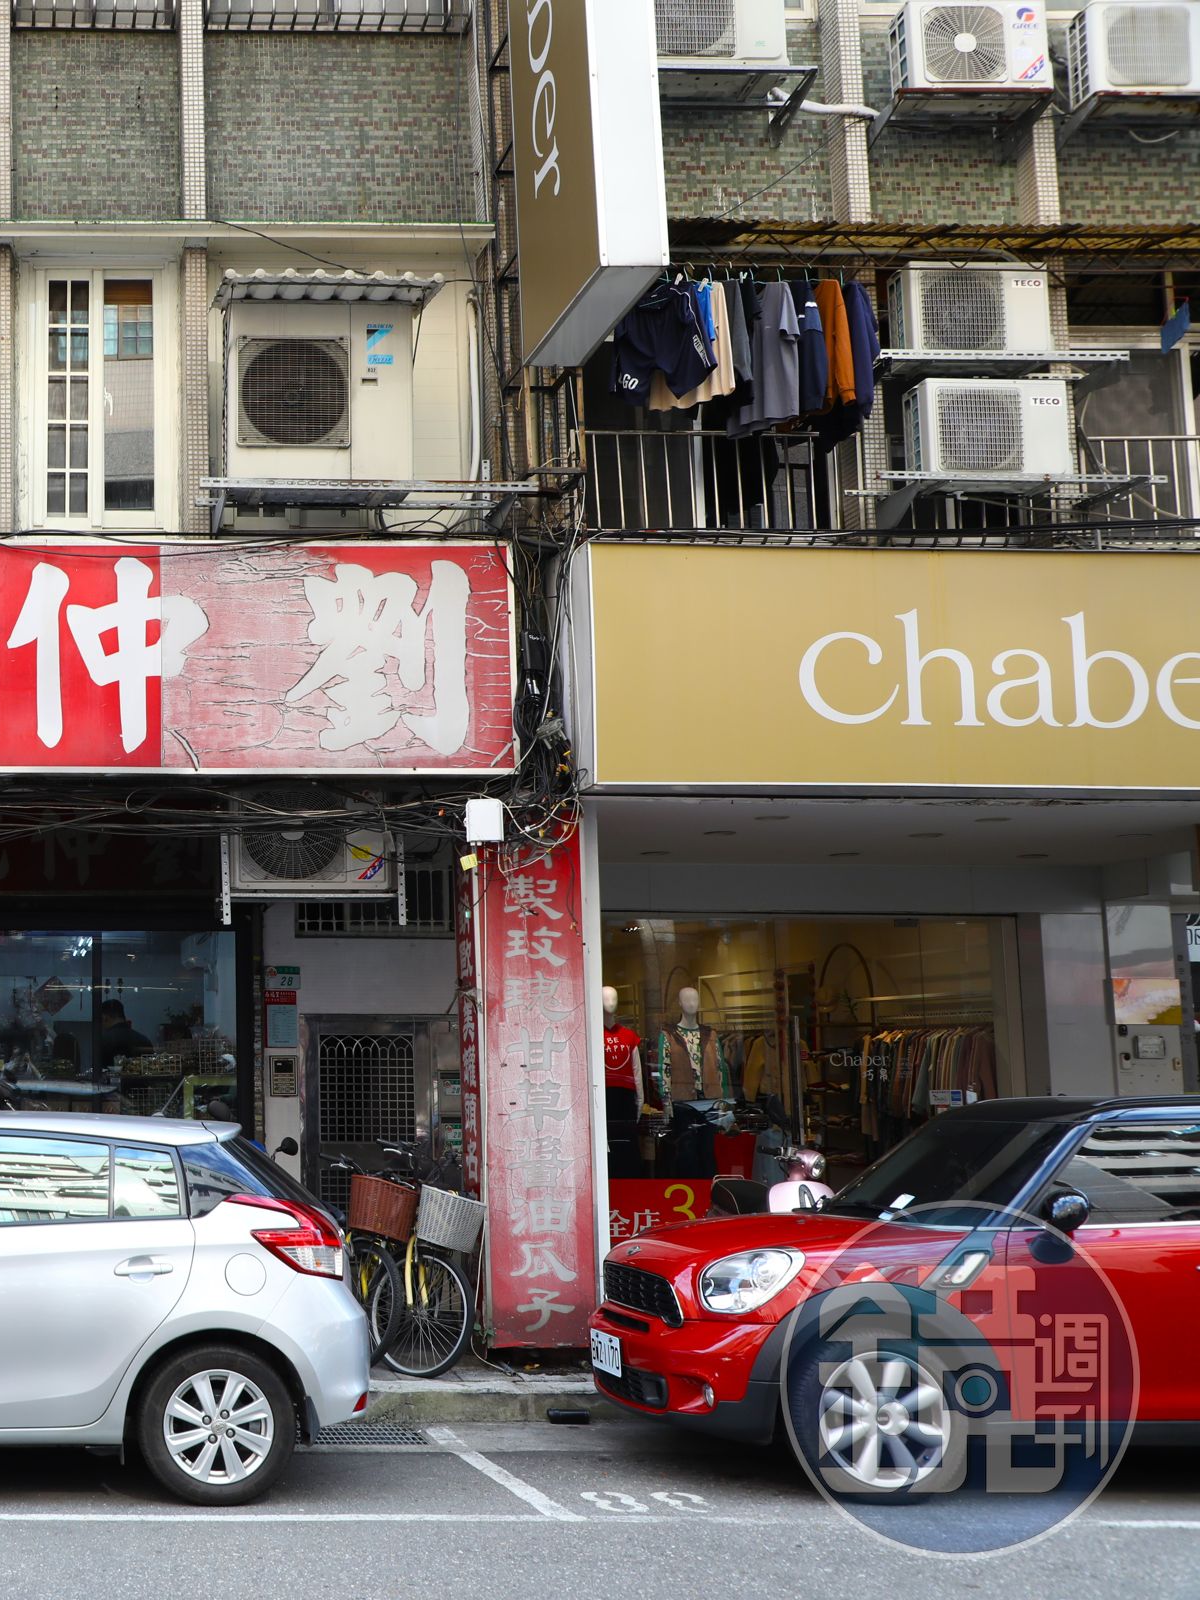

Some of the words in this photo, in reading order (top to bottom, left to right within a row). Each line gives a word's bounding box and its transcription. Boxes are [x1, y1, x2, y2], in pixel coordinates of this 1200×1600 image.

[1013, 279, 1041, 287] TECO
[1032, 397, 1060, 405] TECO
[281, 976, 293, 986] 28
[829, 1050, 890, 1067] Chaber
